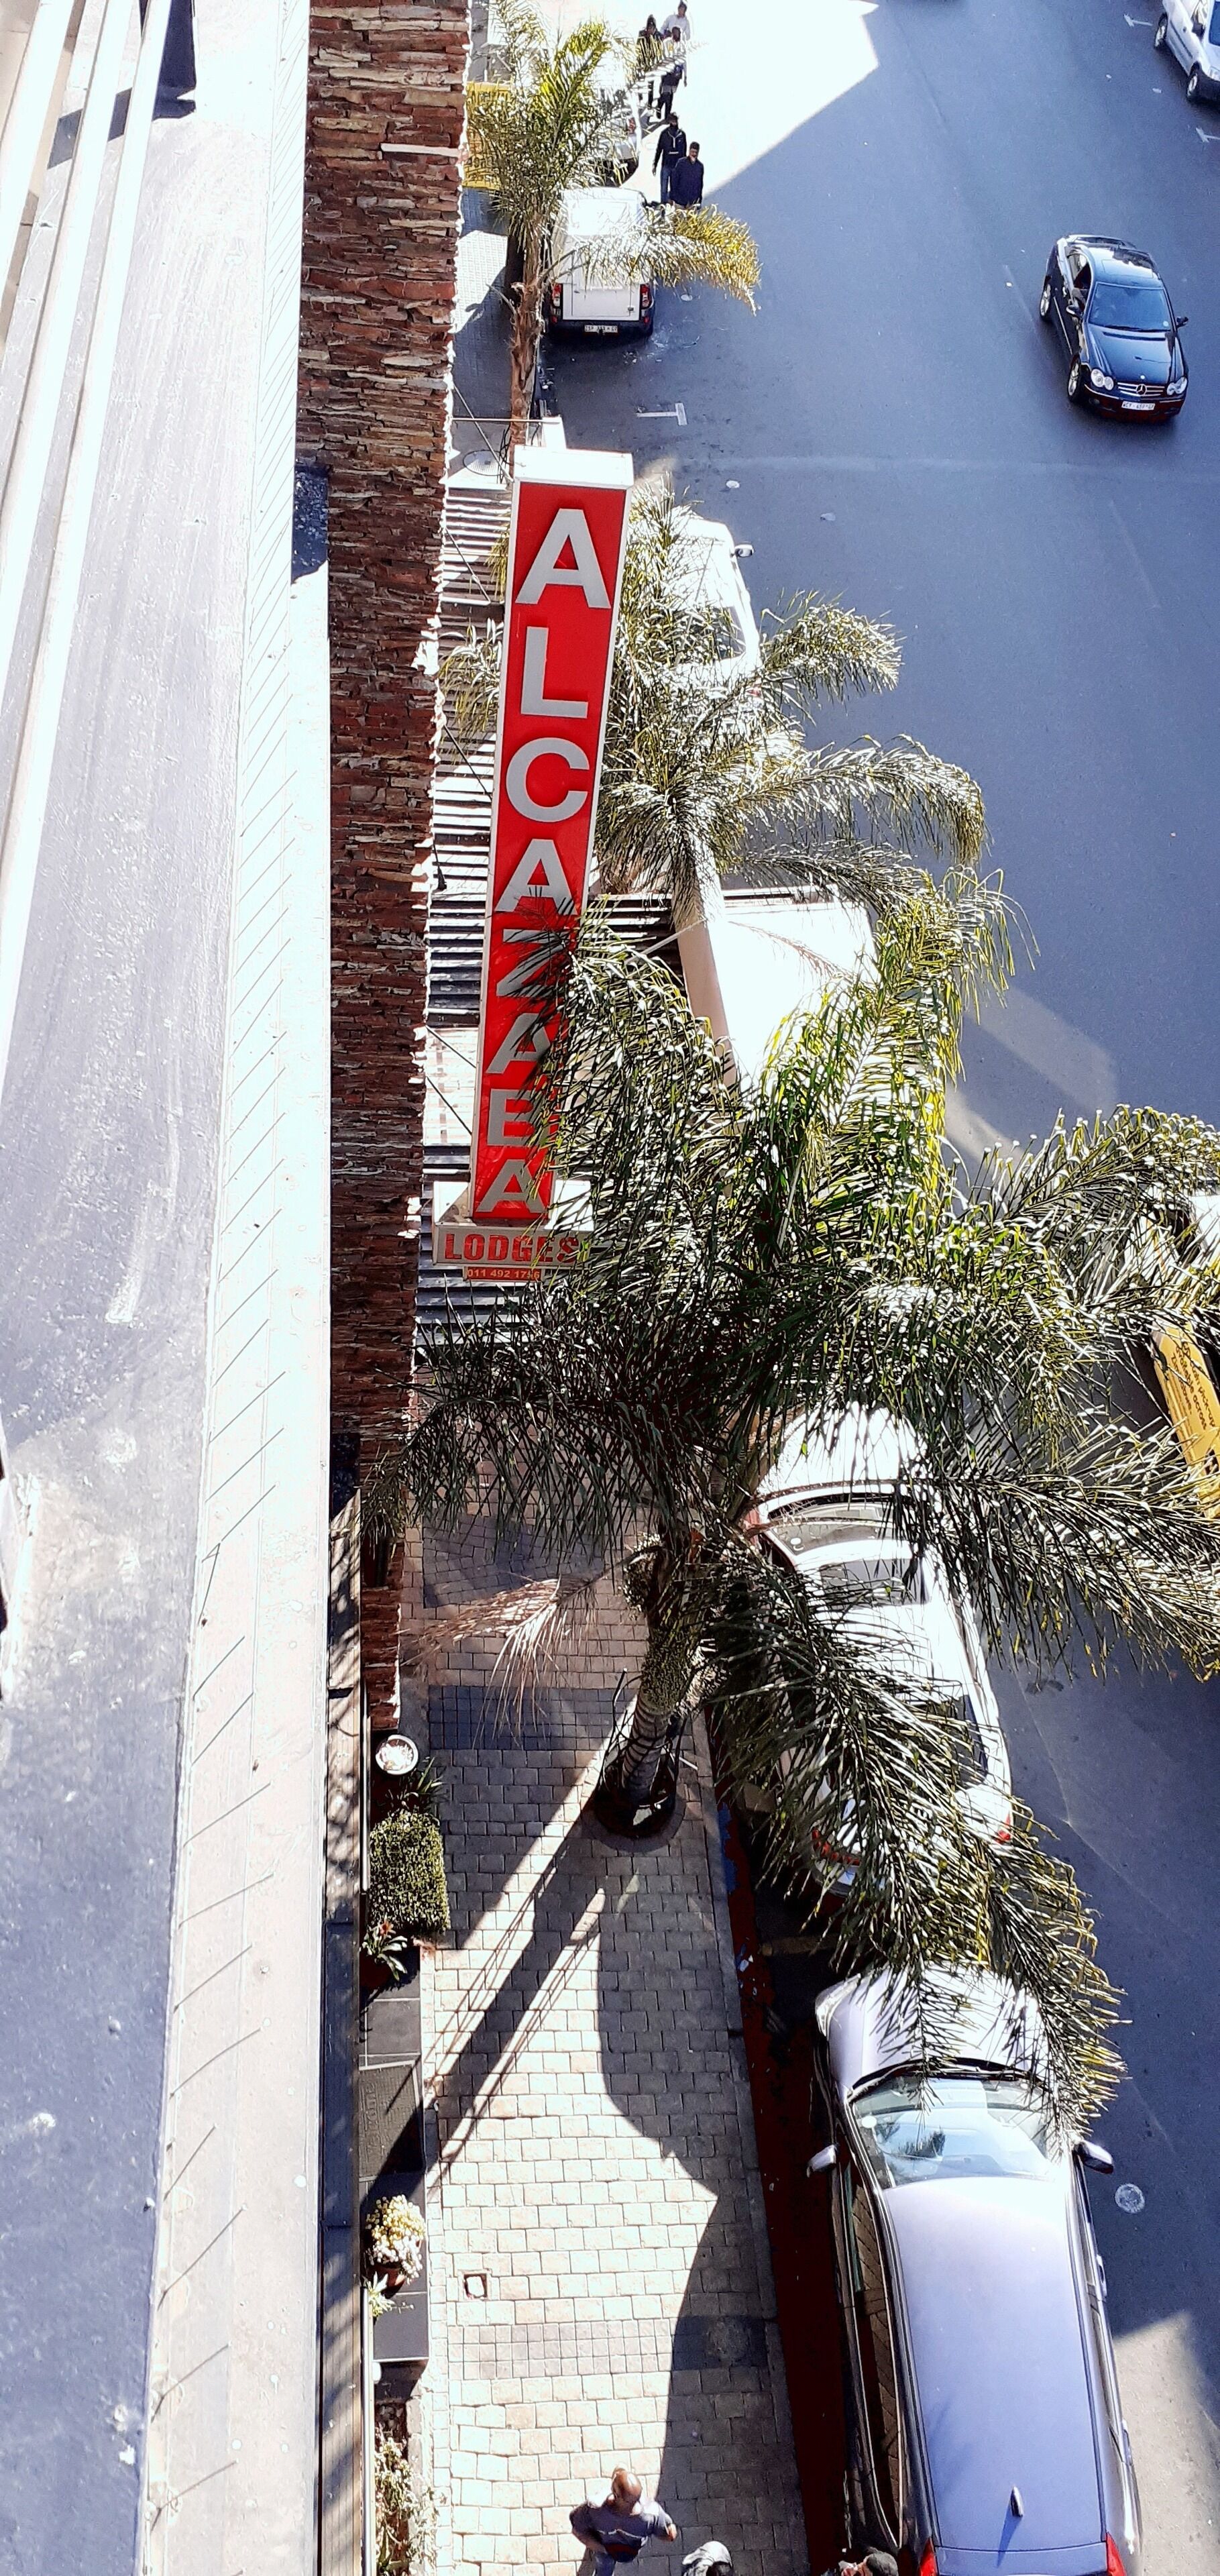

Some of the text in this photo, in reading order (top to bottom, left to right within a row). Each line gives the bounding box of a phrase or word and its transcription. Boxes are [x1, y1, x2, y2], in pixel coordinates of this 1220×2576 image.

[476, 508, 612, 1214] ALCAZABA
[444, 1233, 579, 1263] LODGES
[467, 1269, 486, 1277] 011
[490, 1269, 511, 1278] 492
[1193, 1394, 1207, 1430] across
